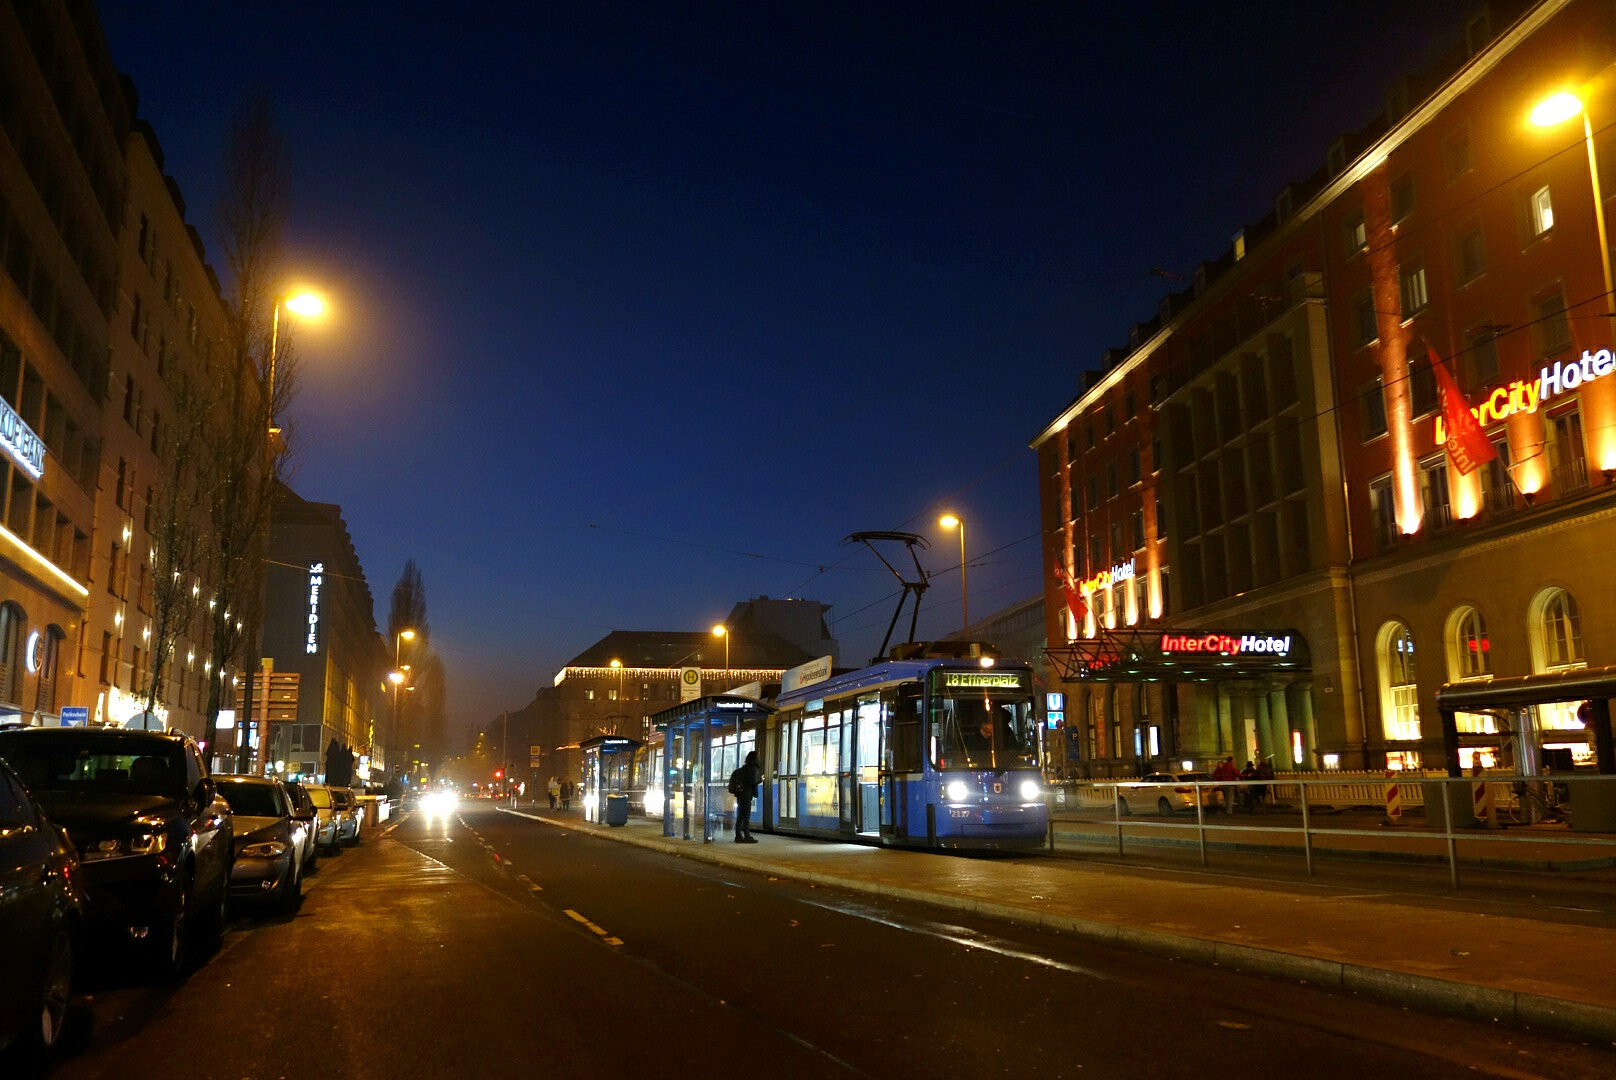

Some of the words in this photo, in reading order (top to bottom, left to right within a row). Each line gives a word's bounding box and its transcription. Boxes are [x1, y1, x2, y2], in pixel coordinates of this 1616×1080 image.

[1079, 557, 1136, 596] InterCityHotel
[306, 575, 322, 654] MERIDIEN
[1161, 634, 1291, 656] InterCityHotel
[946, 674, 959, 686] 18
[961, 673, 1019, 687] Effnerplatz
[1049, 694, 1061, 709] U
